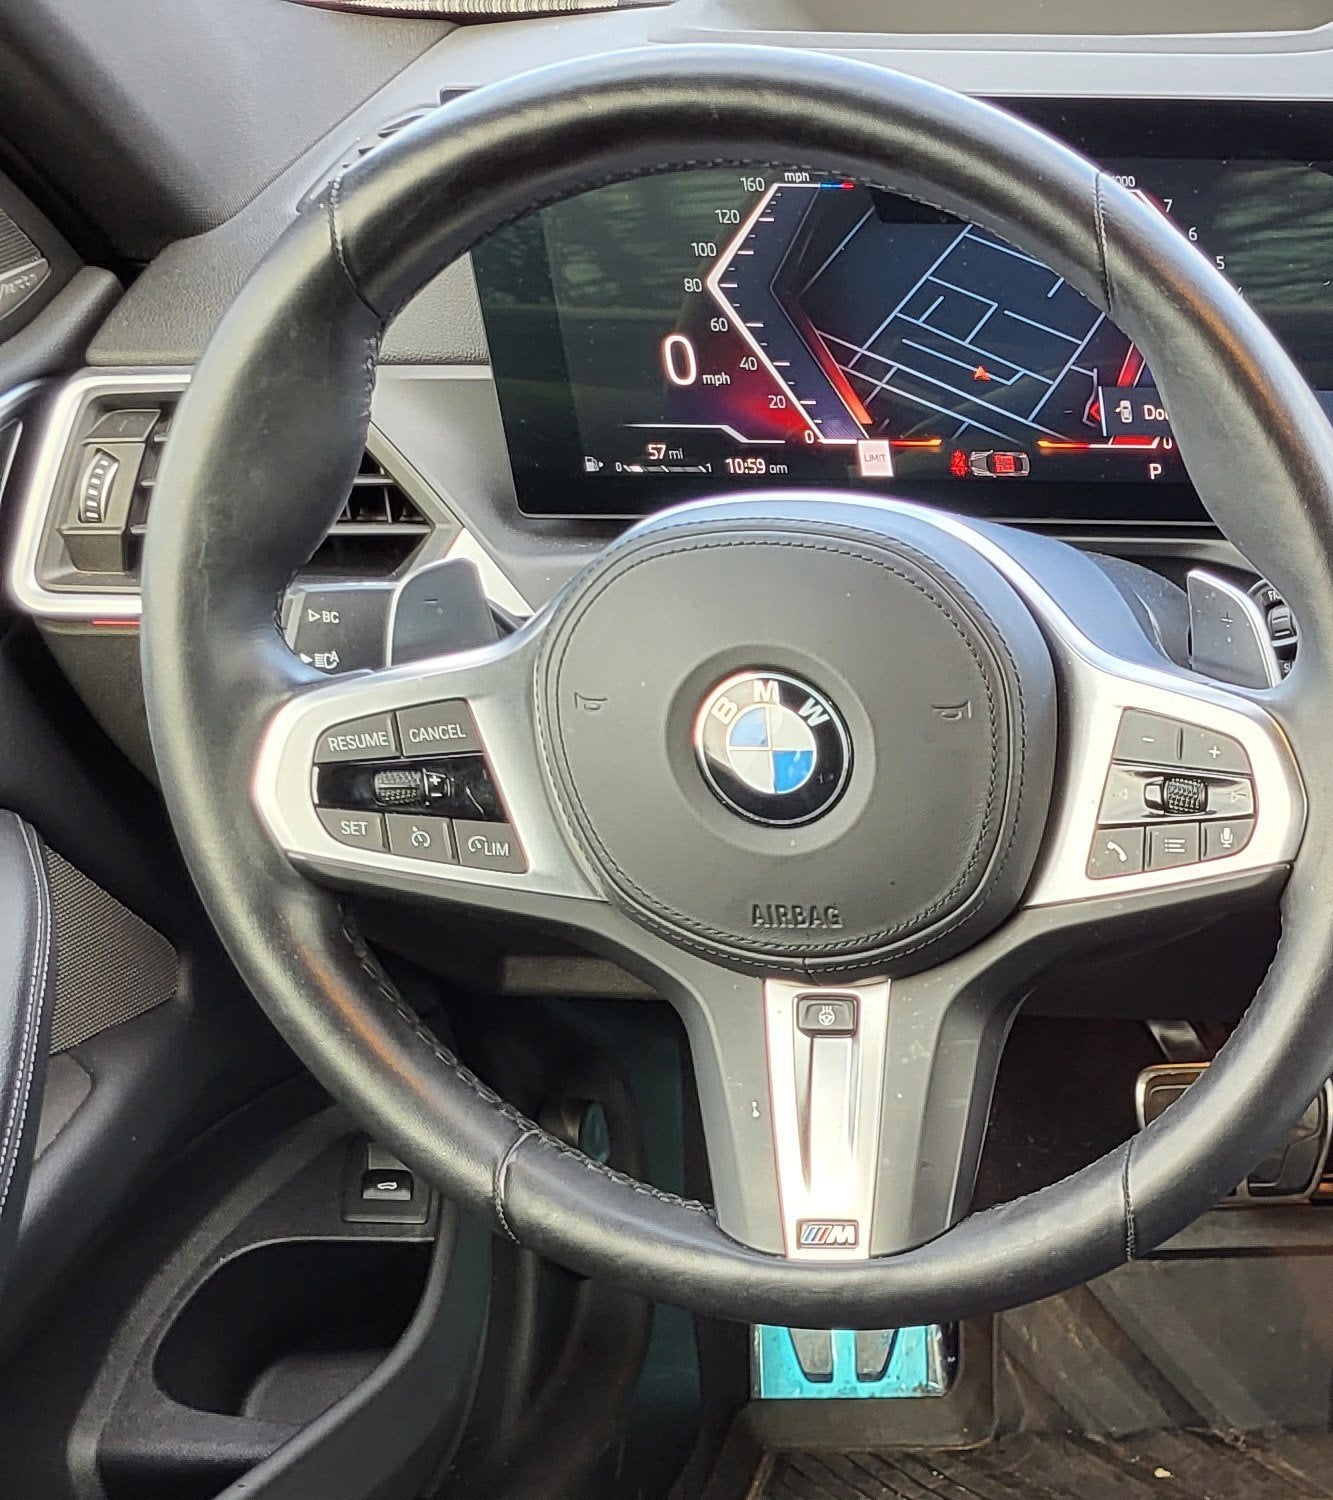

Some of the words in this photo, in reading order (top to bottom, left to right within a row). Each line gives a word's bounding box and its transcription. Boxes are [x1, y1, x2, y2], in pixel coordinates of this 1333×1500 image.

[740, 177, 765, 192] 160
[784, 171, 810, 184] mph
[1164, 199, 1173, 213] 7
[714, 209, 740, 224] 120
[1188, 227, 1198, 241] 6
[691, 242, 717, 257] 100
[1216, 256, 1226, 270] 5
[684, 278, 702, 293] 80
[710, 317, 729, 332] 60
[664, 334, 697, 386] 0
[702, 371, 731, 387] mph
[739, 357, 758, 371] 40
[768, 395, 786, 409] 20
[804, 429, 815, 444] 0
[648, 444, 666, 460] 57
[669, 447, 684, 460] mi
[864, 453, 886, 463] LIMIT
[725, 457, 766, 474] 10:59
[769, 464, 789, 474] am
[1149, 463, 1162, 480] P
[322, 611, 340, 624] BC
[409, 724, 466, 743] CANCEL
[328, 731, 390, 752] RESUME
[340, 821, 368, 836] SET
[485, 842, 509, 857] LIM
[752, 903, 844, 929] AIRBAG
